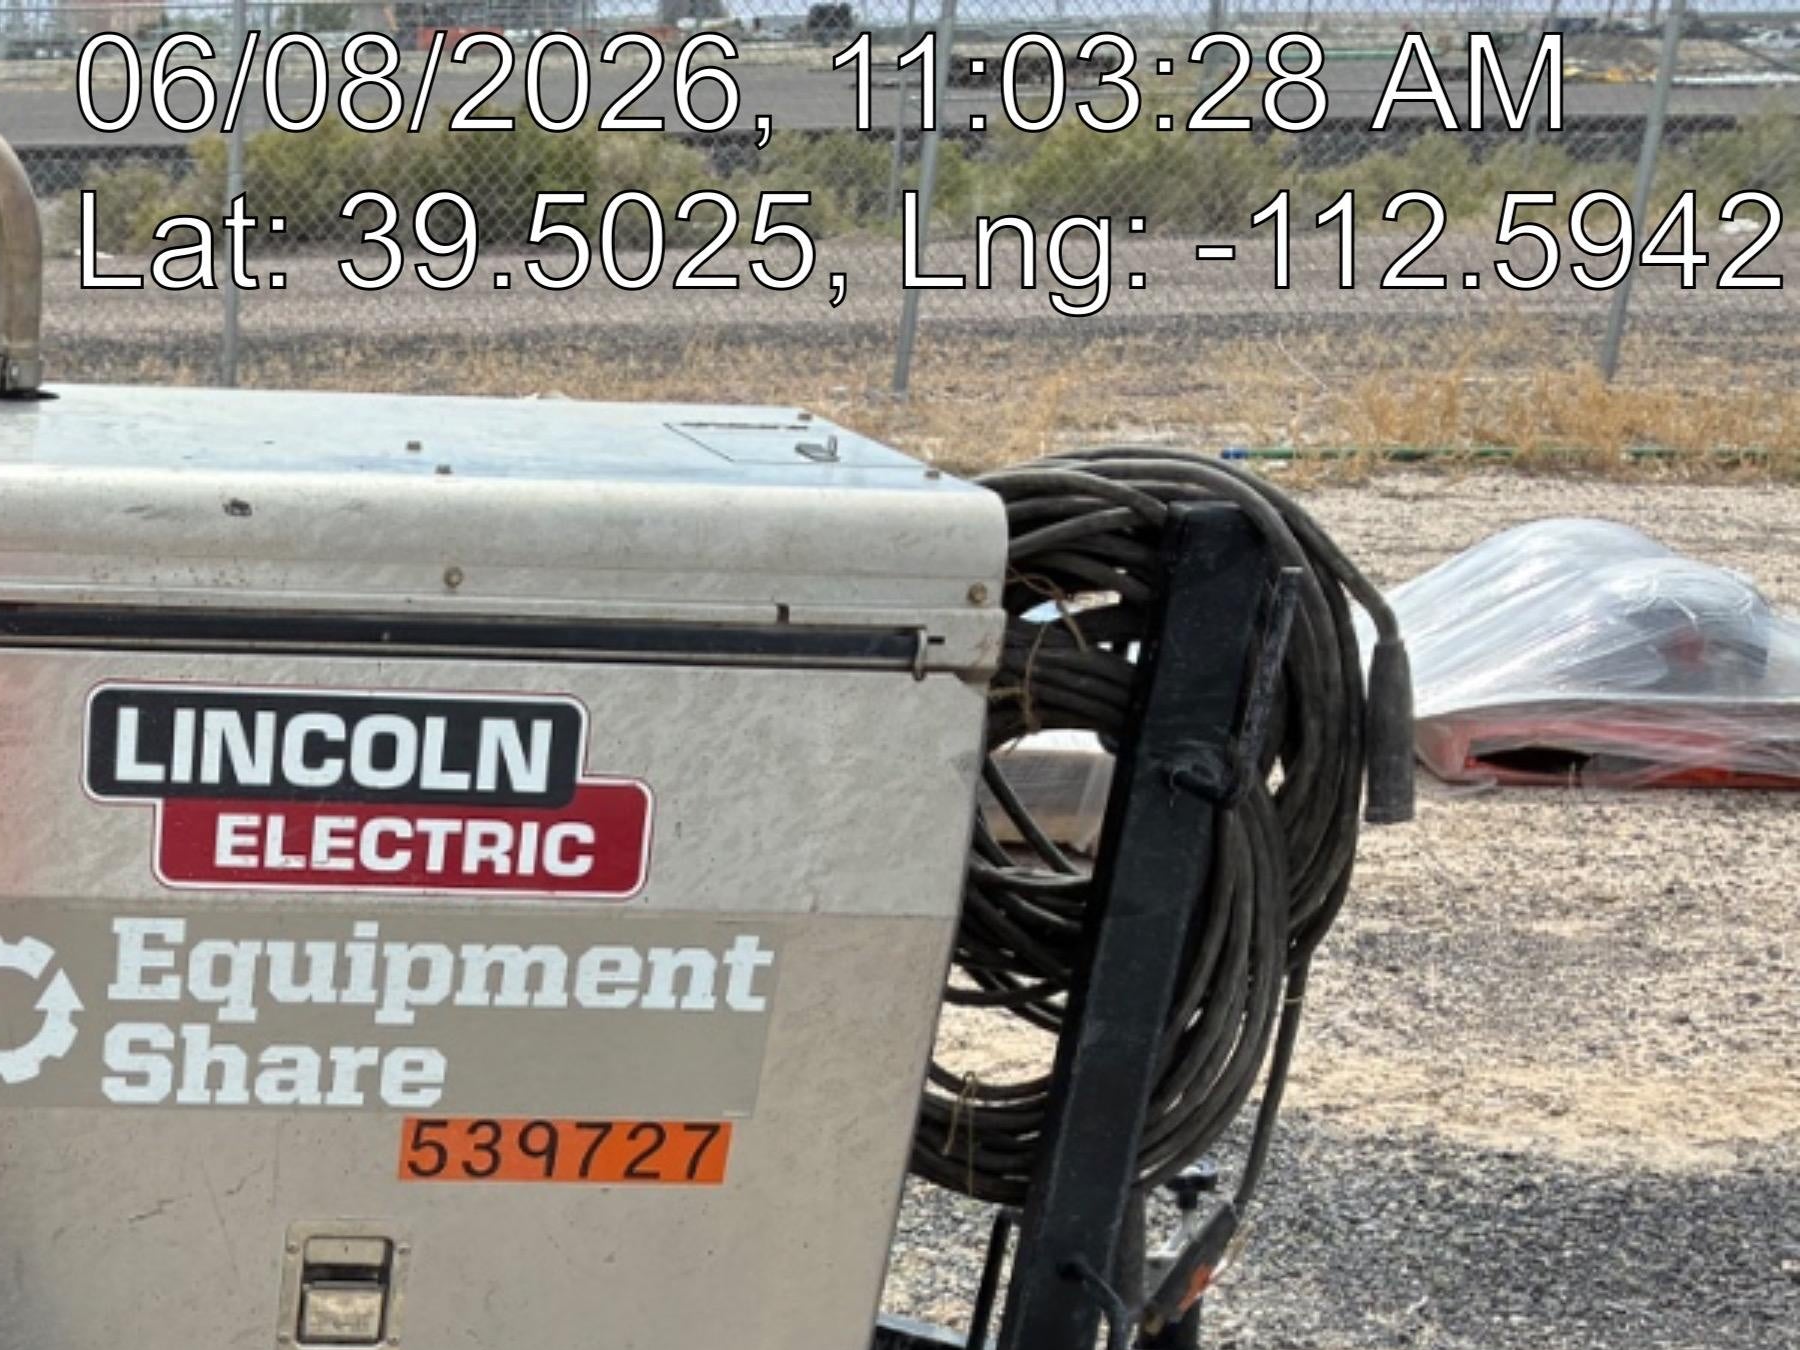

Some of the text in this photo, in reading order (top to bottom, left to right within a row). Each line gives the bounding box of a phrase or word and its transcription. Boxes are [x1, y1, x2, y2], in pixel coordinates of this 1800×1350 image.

[114, 706, 553, 793] LINCOLN
[213, 813, 596, 877] ELECTRIC
[106, 916, 775, 1024] Equipment
[100, 1021, 448, 1109] Share
[407, 1120, 722, 1180] 539727
